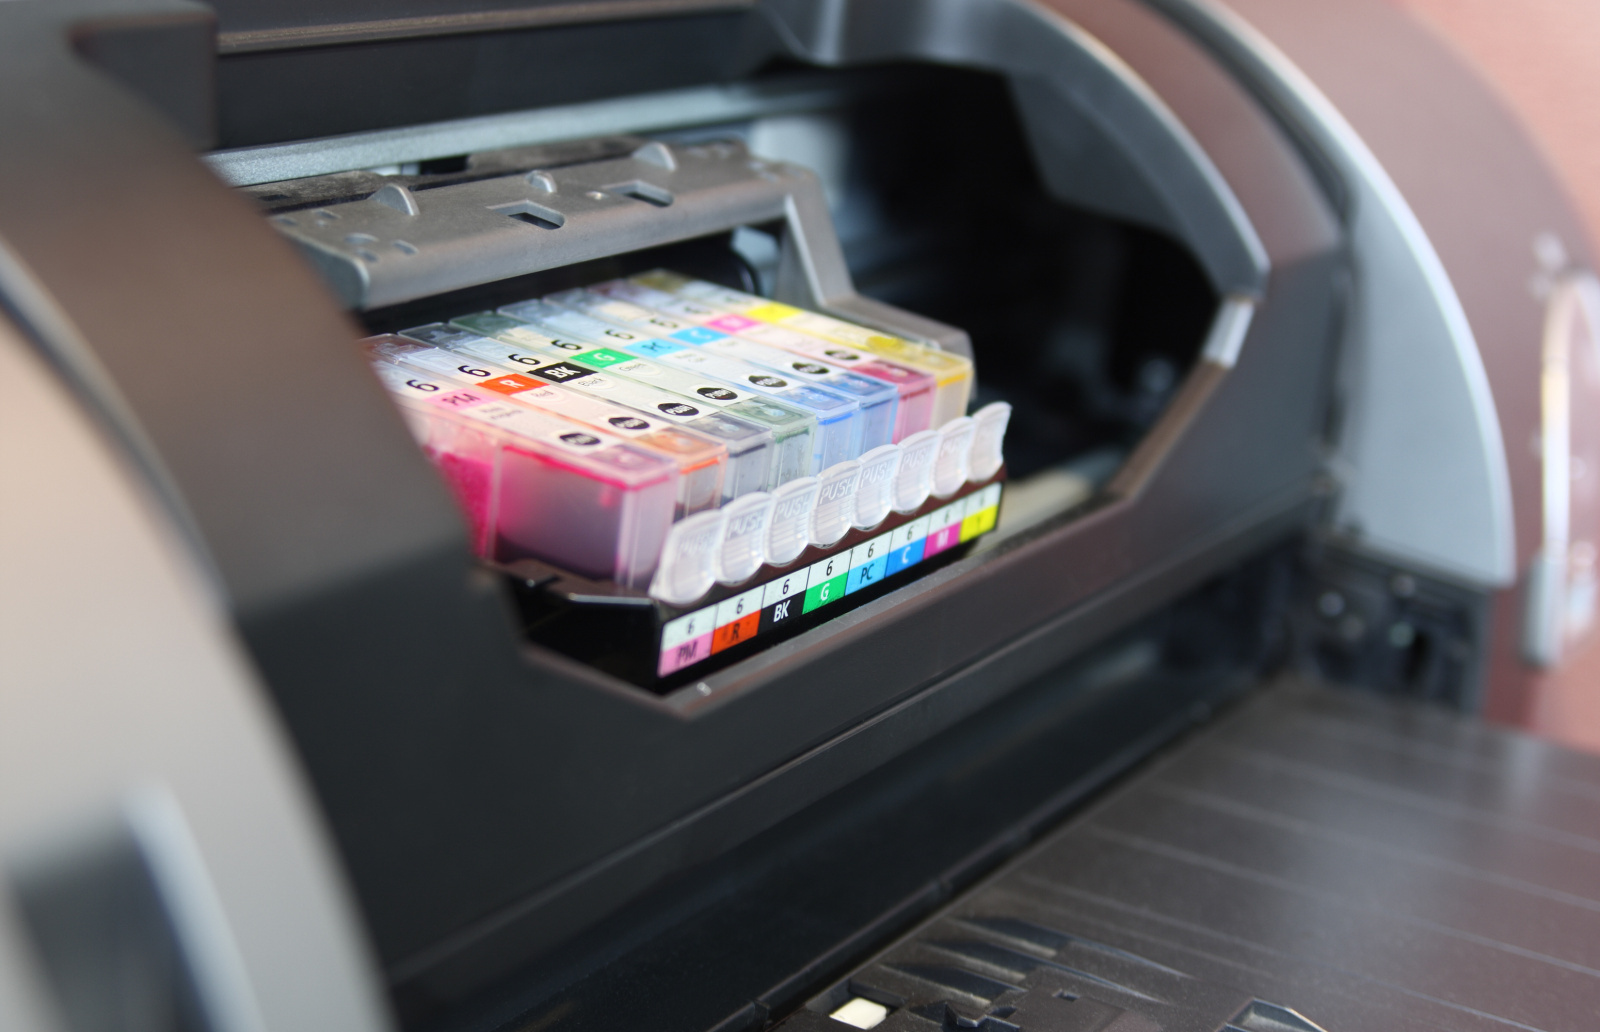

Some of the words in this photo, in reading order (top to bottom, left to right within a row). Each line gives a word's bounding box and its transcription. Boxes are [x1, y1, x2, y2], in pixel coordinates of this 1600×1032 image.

[604, 328, 635, 340] 6
[550, 339, 583, 350] 6
[508, 353, 541, 366] 6
[593, 352, 617, 362] G
[457, 365, 491, 378] 6
[544, 366, 582, 379] BK
[406, 379, 440, 392] 6
[499, 379, 525, 389] R
[820, 474, 857, 505] PUSH
[774, 491, 813, 524] PUSH
[906, 524, 915, 541] 6
[867, 542, 875, 558] 6
[901, 546, 911, 564] C
[826, 560, 834, 576] 6
[860, 563, 875, 585] PC
[782, 579, 790, 595] 6
[820, 582, 830, 602] G
[736, 598, 744, 615] 6
[773, 599, 791, 623] BK
[687, 617, 696, 635] 6
[731, 622, 740, 642] R
